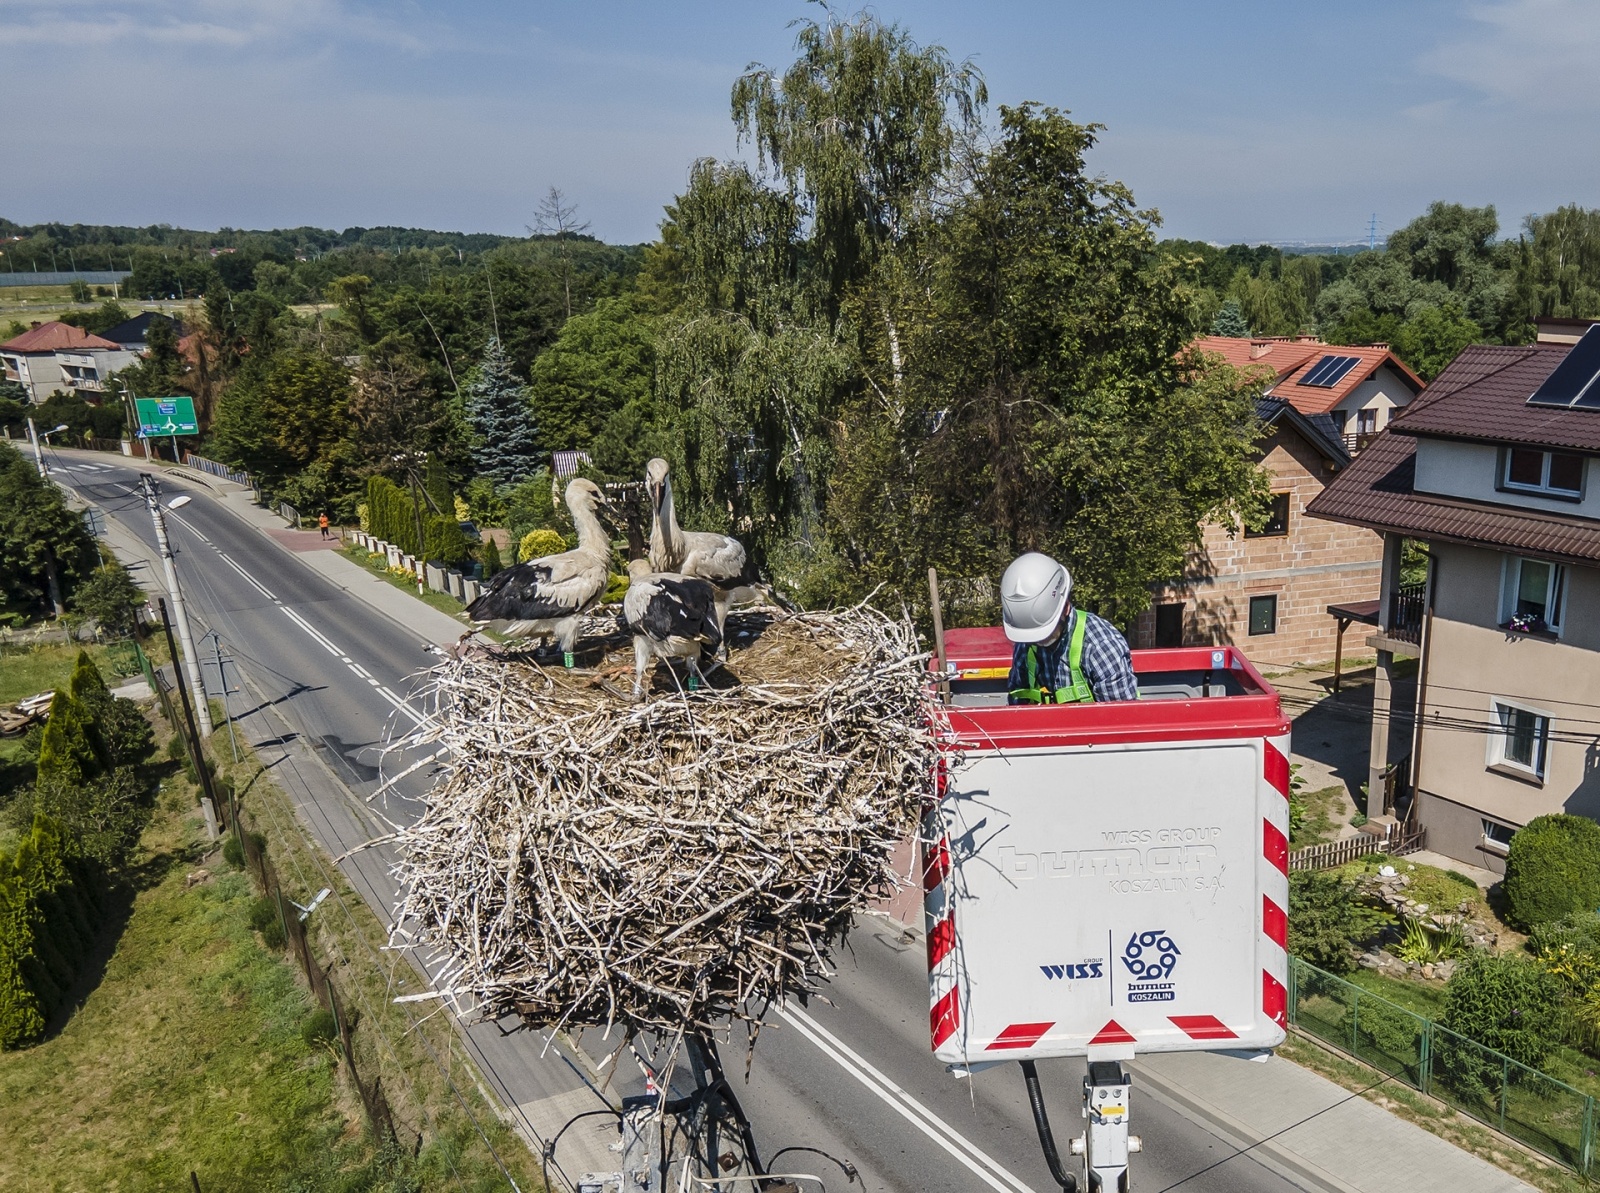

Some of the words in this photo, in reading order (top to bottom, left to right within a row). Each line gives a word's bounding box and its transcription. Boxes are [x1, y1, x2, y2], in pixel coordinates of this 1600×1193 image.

[1102, 830, 1152, 844] WISS
[1156, 828, 1222, 843] GROUP
[998, 845, 1217, 880] bumar
[1109, 879, 1189, 895] KOSZALIN
[1195, 876, 1226, 891] S.A.
[1039, 963, 1104, 980] WISS
[1127, 983, 1175, 991] bumar
[1131, 992, 1172, 1002] KOSZALIN
